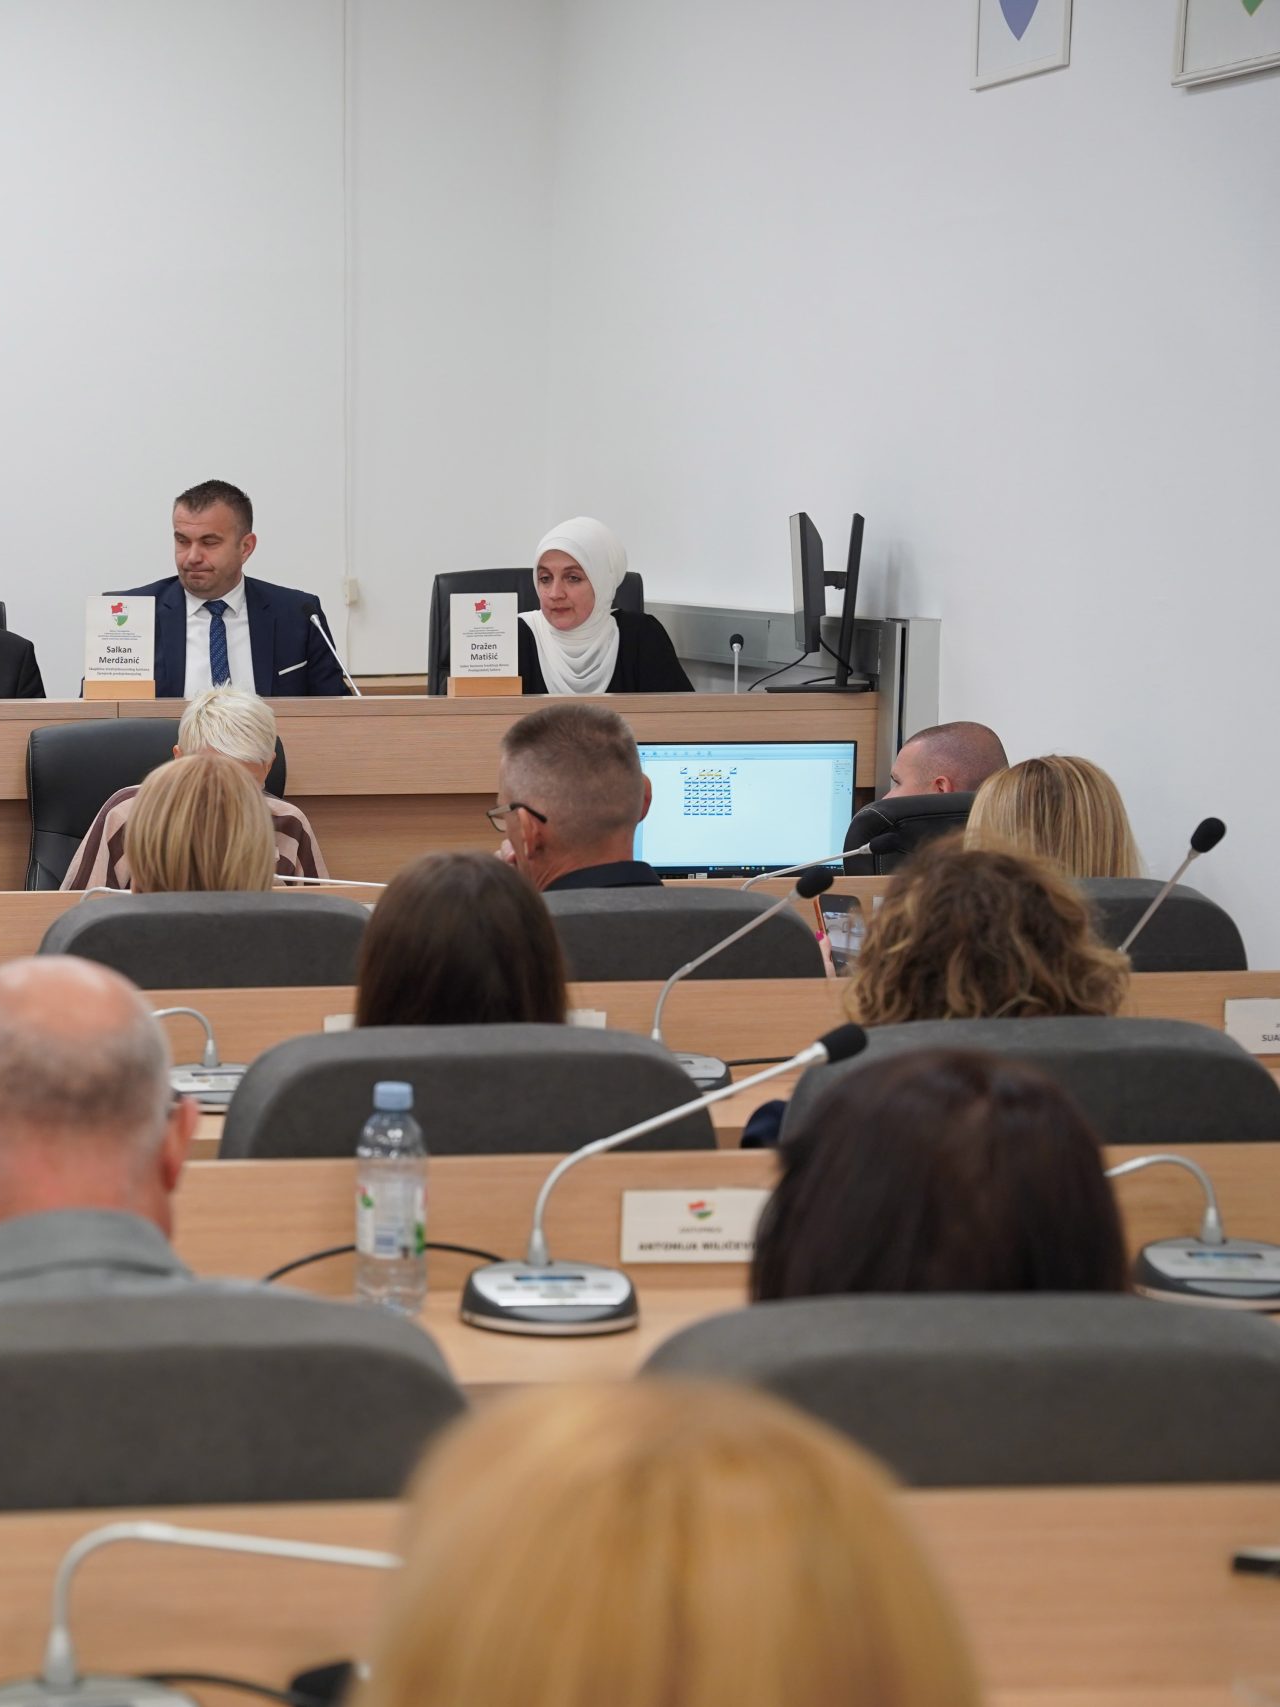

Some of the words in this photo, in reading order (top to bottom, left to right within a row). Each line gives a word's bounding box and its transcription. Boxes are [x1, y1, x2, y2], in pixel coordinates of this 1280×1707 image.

[106, 646, 132, 654] Salkan
[470, 642, 497, 651] Dražen
[98, 656, 140, 664] Merdžanić
[470, 652, 498, 661] Matišić
